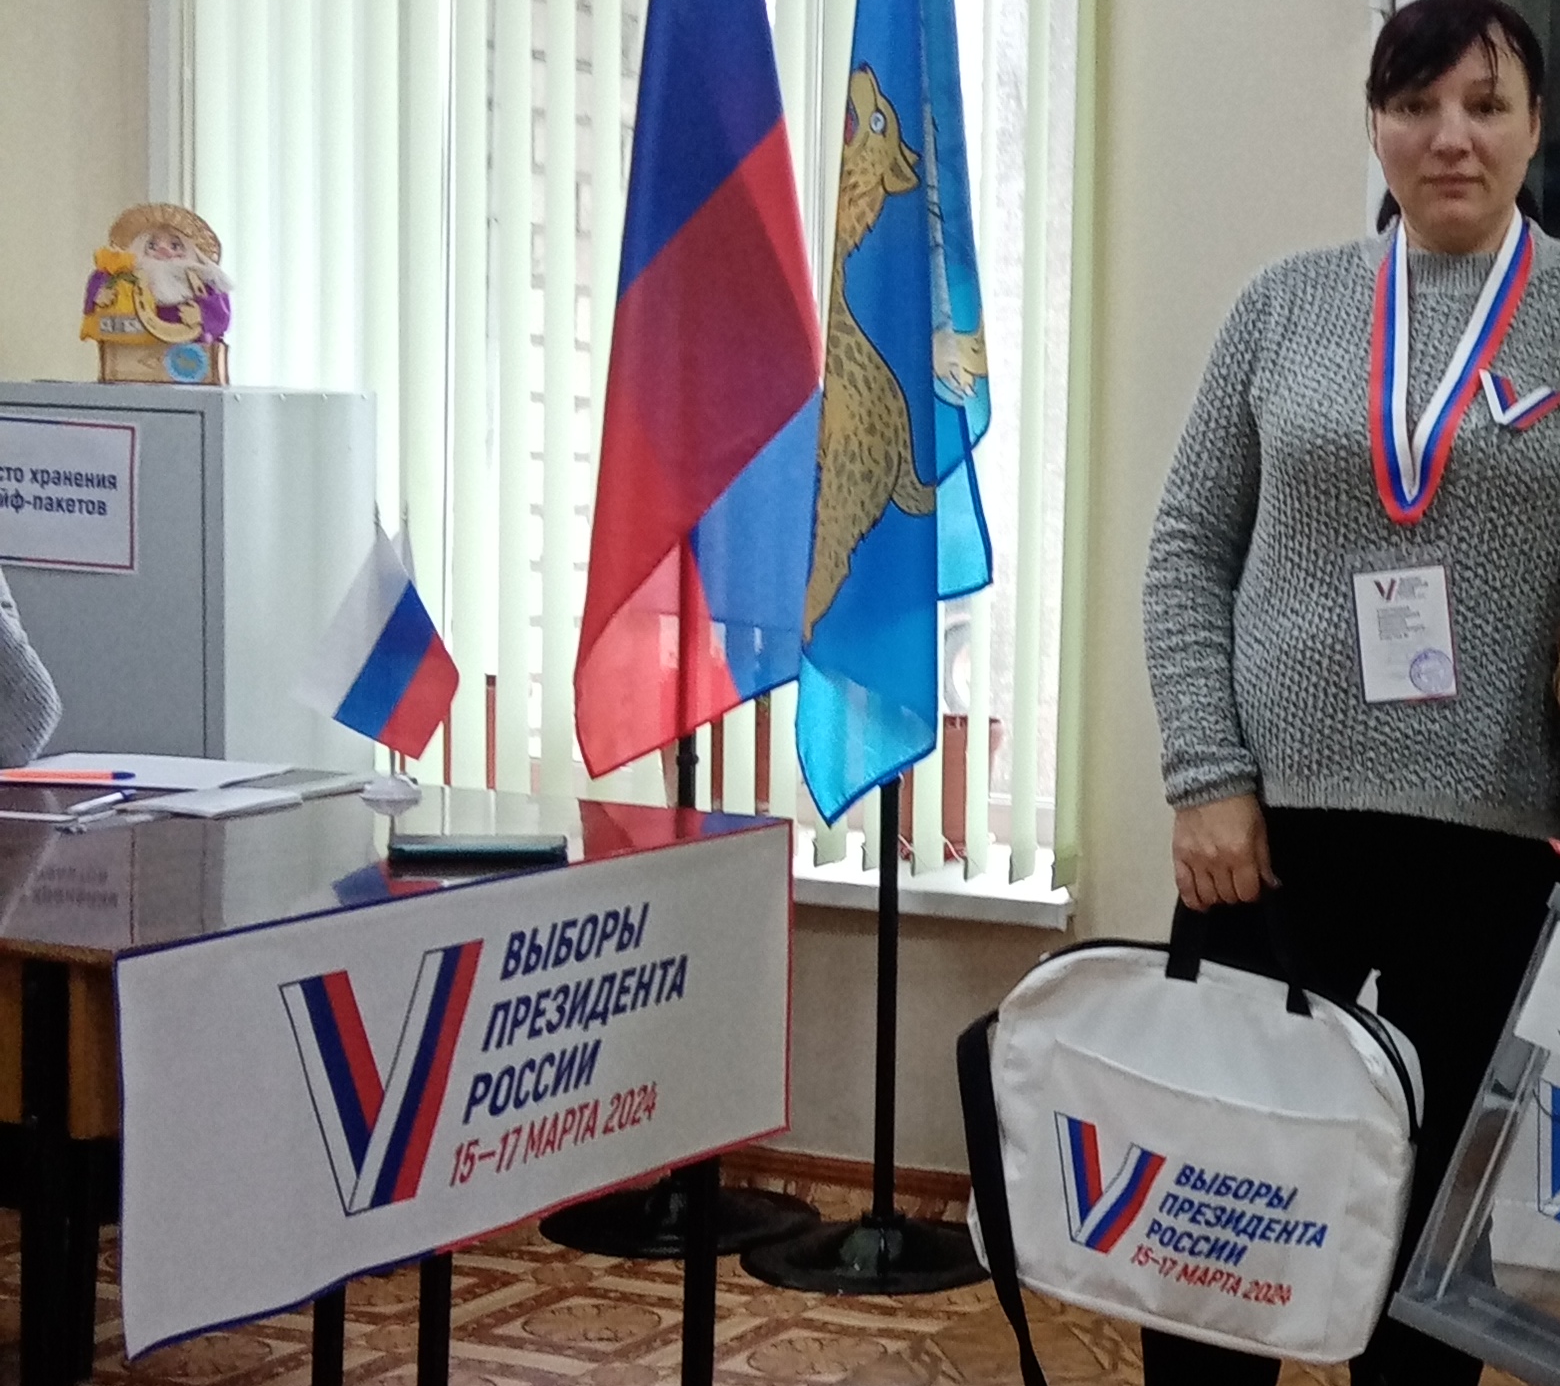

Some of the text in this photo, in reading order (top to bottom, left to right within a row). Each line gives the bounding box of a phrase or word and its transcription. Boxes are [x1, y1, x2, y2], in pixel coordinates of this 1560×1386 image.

[0, 488, 108, 515] йф-пакетов
[29, 468, 118, 491] хранения
[500, 902, 650, 981] ВЫБОРЫ
[481, 954, 689, 1052] ПРЕЗИДЕНТА
[462, 1039, 601, 1125] РОССИИ
[522, 1100, 600, 1164] МАРТА
[600, 1080, 658, 1136] 2024
[1174, 1163, 1298, 1211] ВЫБОРЫ
[1146, 1218, 1249, 1266] РОССИИ
[1158, 1191, 1328, 1248] ПРЕЗИДЕНТА
[1175, 1262, 1242, 1297] МАРТА
[1242, 1279, 1293, 1306] 2024
